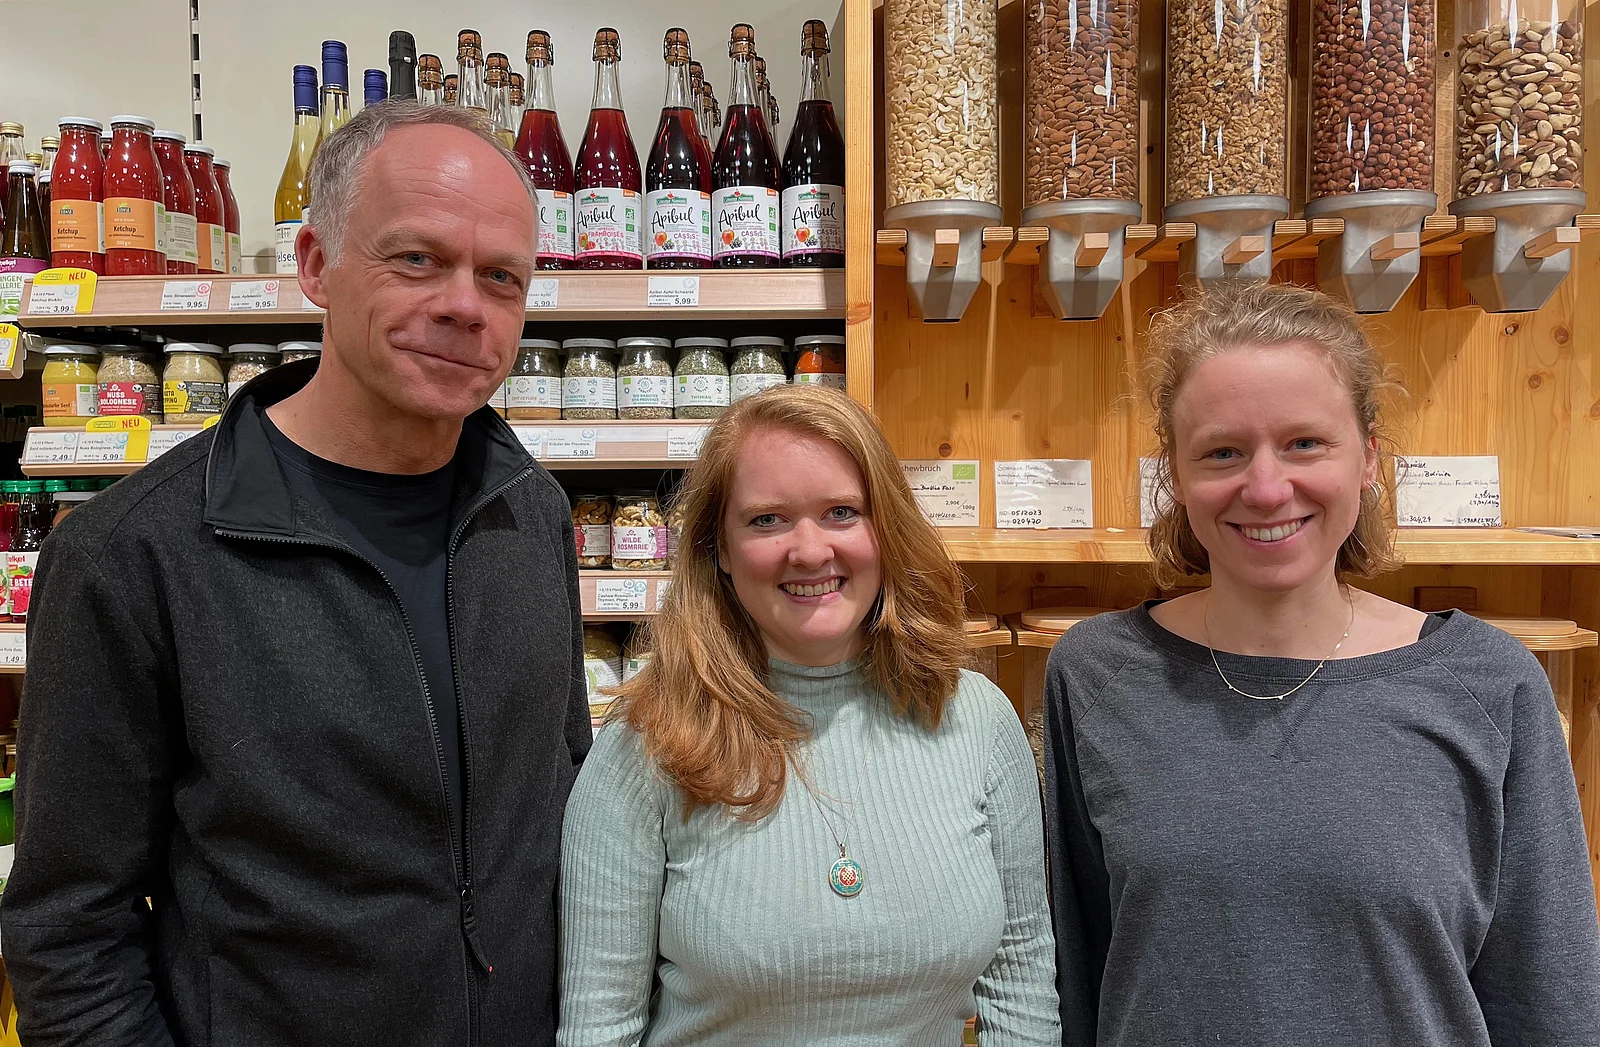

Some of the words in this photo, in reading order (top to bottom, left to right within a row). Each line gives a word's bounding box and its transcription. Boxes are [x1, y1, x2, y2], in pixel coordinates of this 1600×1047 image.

[577, 205, 618, 234] Apibul
[651, 207, 695, 234] Apibul
[718, 204, 762, 232] Apibul
[792, 202, 837, 230] Apibul
[57, 227, 78, 237] Ketchup
[69, 271, 87, 281] NEU
[186, 301, 203, 309] 9,95
[675, 297, 691, 305] 5,99
[53, 305, 70, 314] 3,99
[100, 398, 138, 406] BOLOGNESE
[122, 419, 140, 429] NEU
[103, 453, 119, 461] 5,99
[573, 449, 589, 457] 5,99
[52, 454, 69, 462] 2,49
[14, 578, 32, 587] BETE
[622, 601, 639, 610] 5,99
